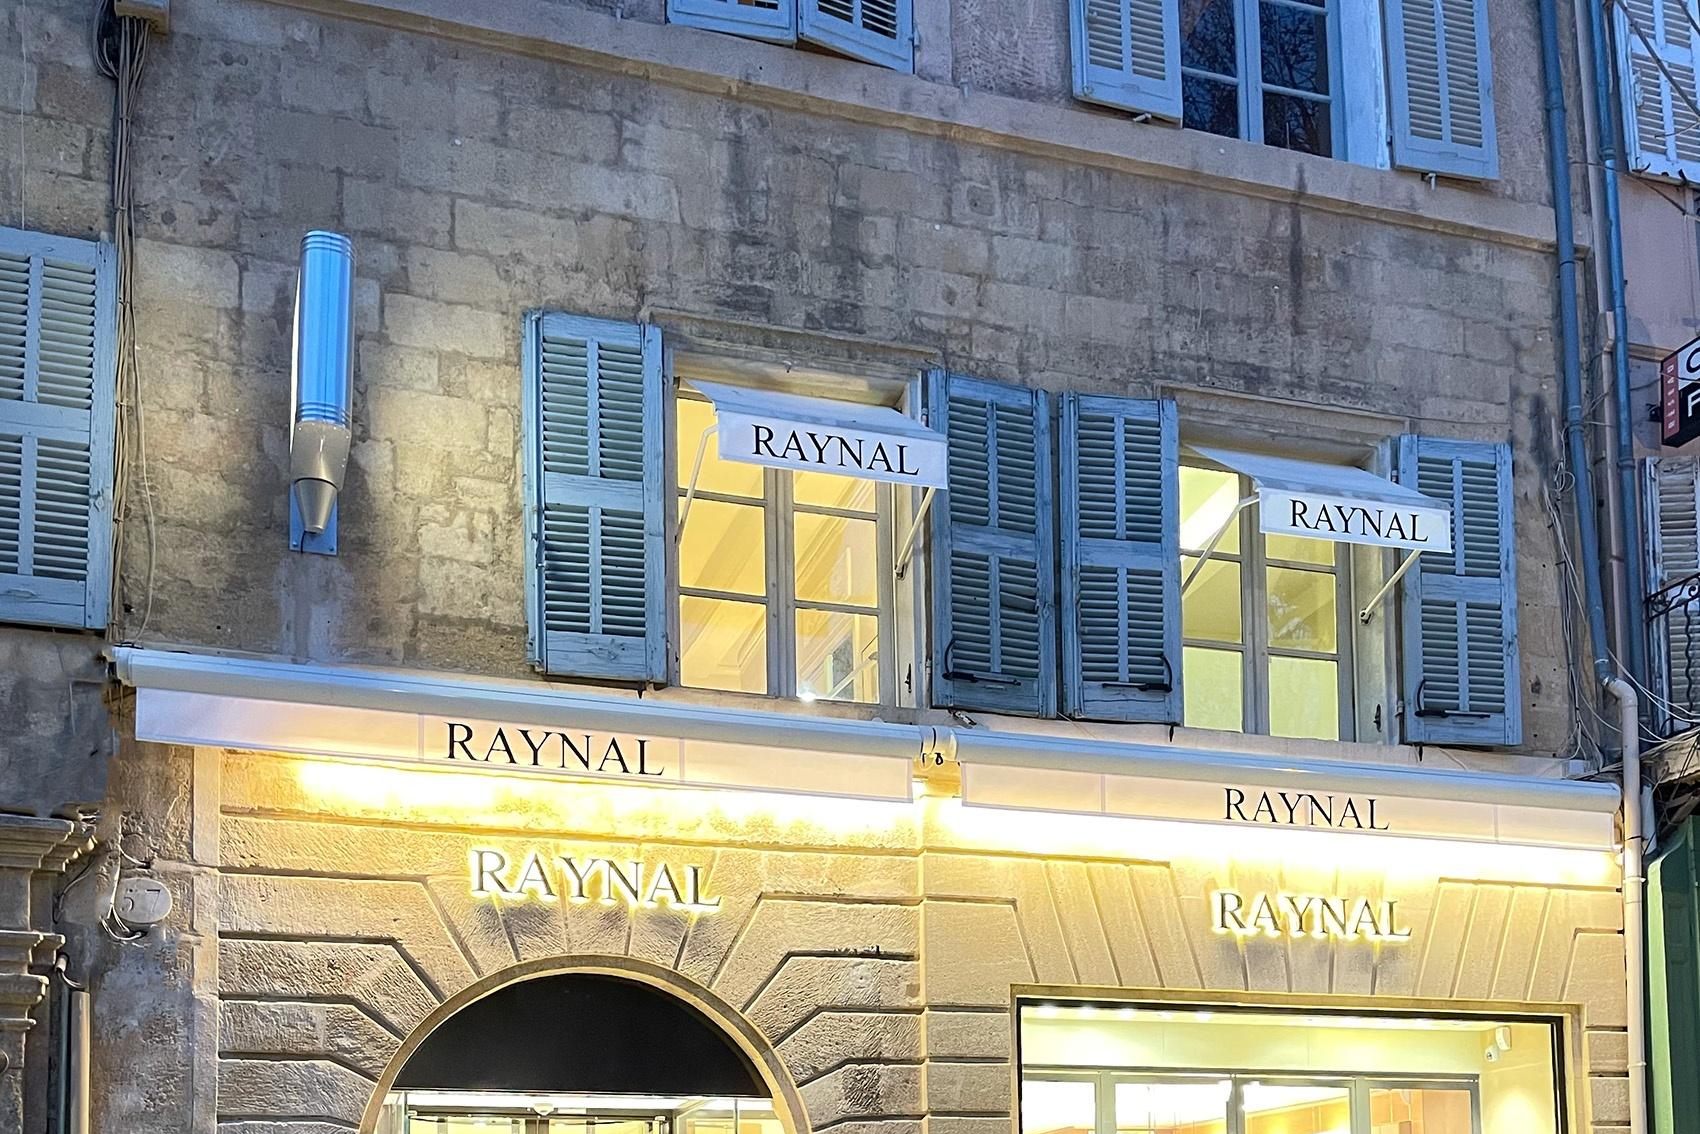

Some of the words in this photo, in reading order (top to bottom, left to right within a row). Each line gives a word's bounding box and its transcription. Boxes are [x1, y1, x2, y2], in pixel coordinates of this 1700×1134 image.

[751, 424, 920, 476] RAYNAL
[1288, 498, 1429, 542] RAYNAL
[443, 721, 665, 776] RAYNAL
[1223, 787, 1390, 830] RAYNAL
[471, 849, 723, 907] RAYNAL
[1218, 892, 1413, 937] RAYNAL
